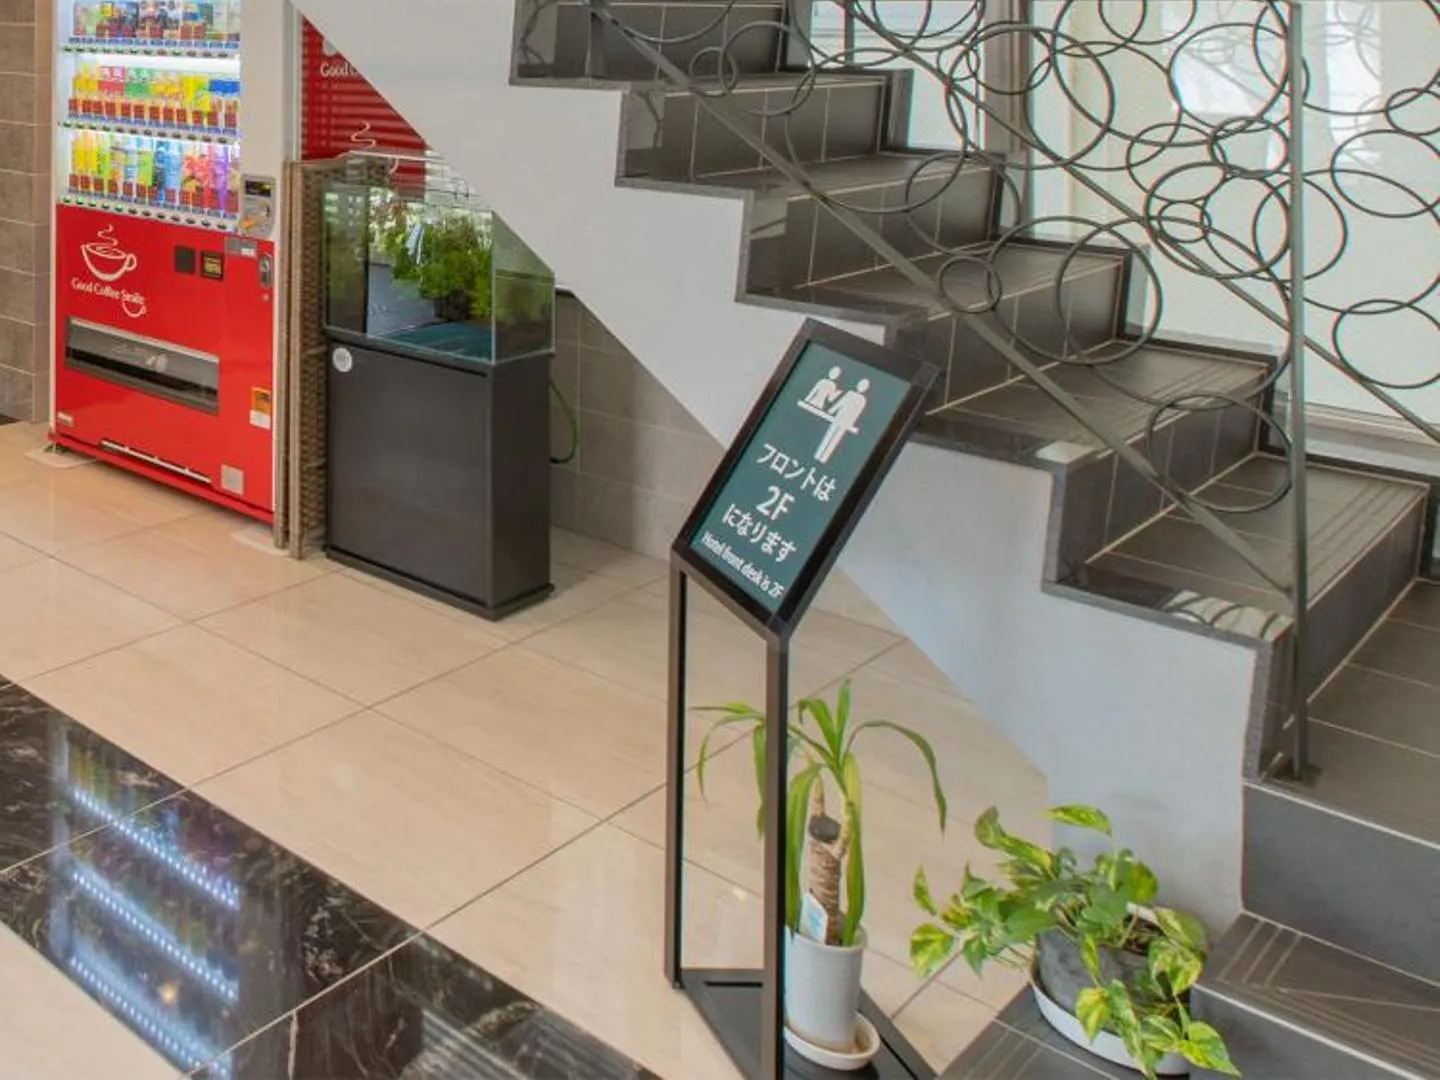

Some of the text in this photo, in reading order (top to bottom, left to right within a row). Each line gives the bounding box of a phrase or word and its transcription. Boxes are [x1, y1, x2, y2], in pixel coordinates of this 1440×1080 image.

[320, 60, 348, 78] Good
[71, 277, 93, 293] Good
[756, 443, 837, 502] フロントは
[756, 485, 796, 520] 2F
[722, 503, 797, 562] になります
[701, 531, 727, 556] Hotel
[741, 563, 764, 586] desk
[760, 575, 771, 592] is
[768, 582, 785, 598] 2F
